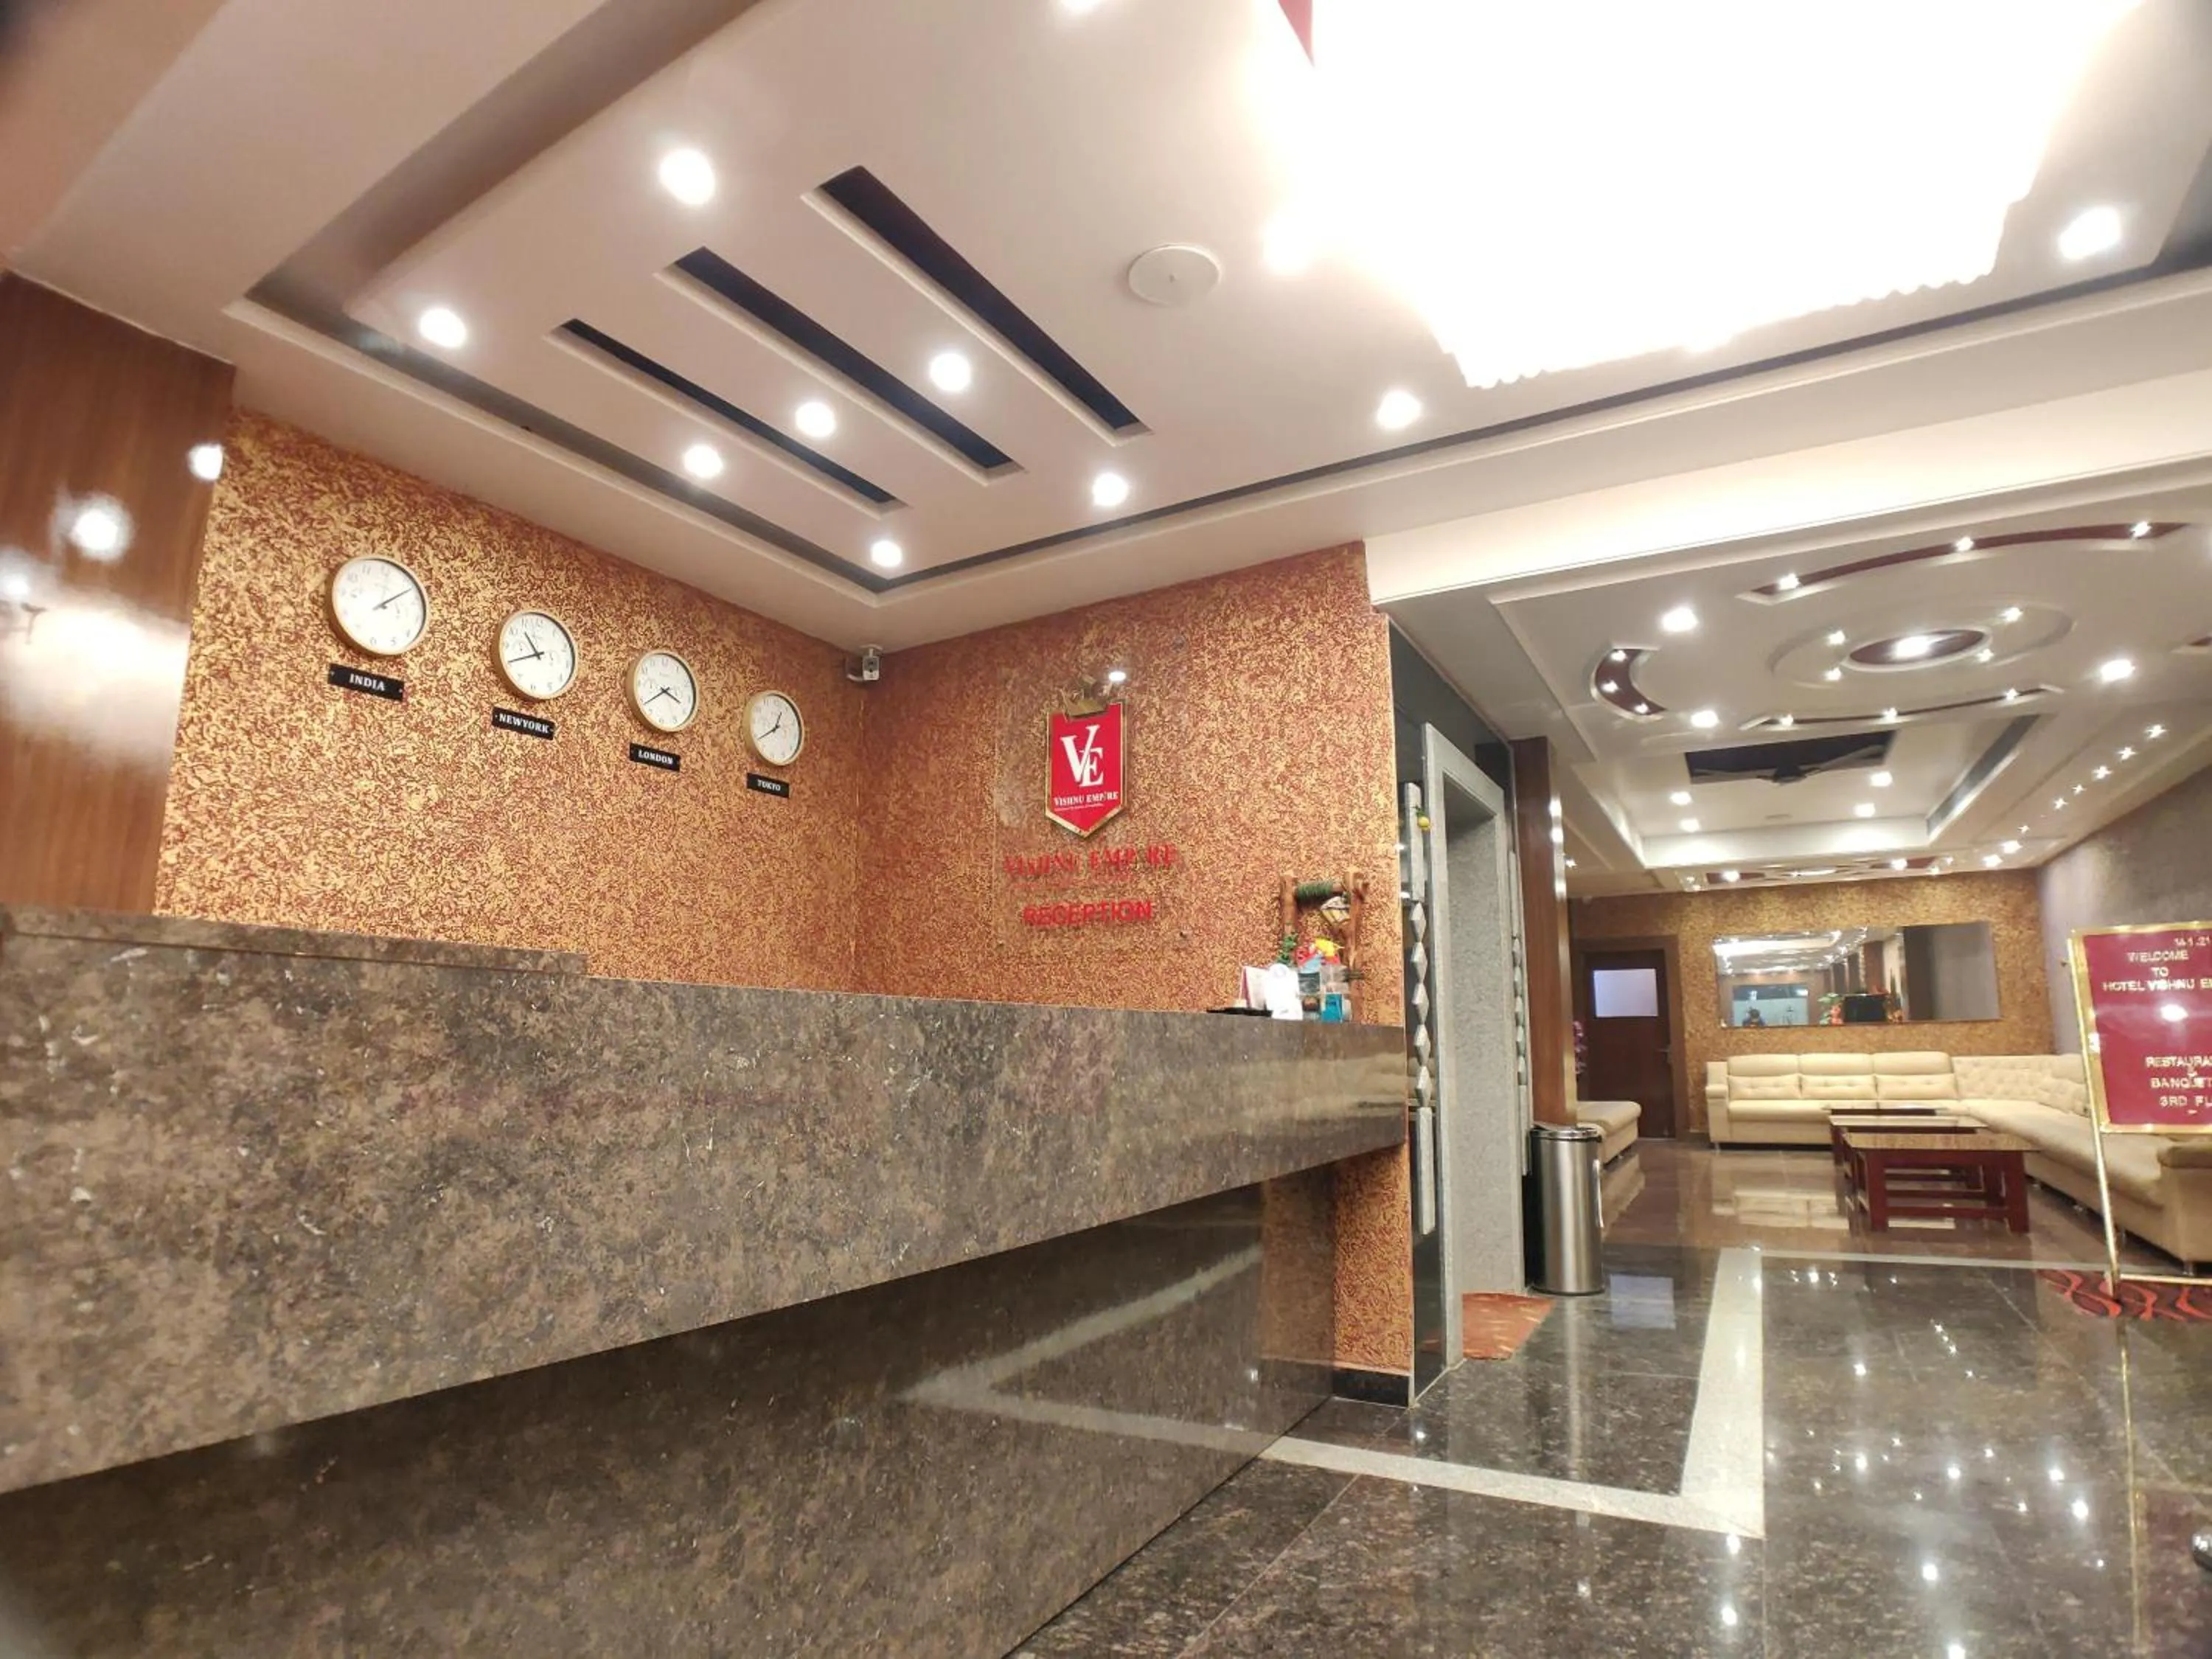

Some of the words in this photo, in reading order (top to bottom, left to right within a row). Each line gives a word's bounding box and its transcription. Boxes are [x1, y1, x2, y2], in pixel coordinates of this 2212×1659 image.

[349, 673, 386, 692] INDIA
[498, 713, 549, 734] NEWYORK
[638, 749, 673, 765] LONDON
[757, 779, 782, 791] TOKYO
[1021, 899, 1153, 926] RECEPTION
[2126, 949, 2189, 963] WELCOME
[2150, 966, 2169, 977] TO
[2101, 979, 2146, 992] HOTEL
[2146, 978, 2195, 991] VISHNU
